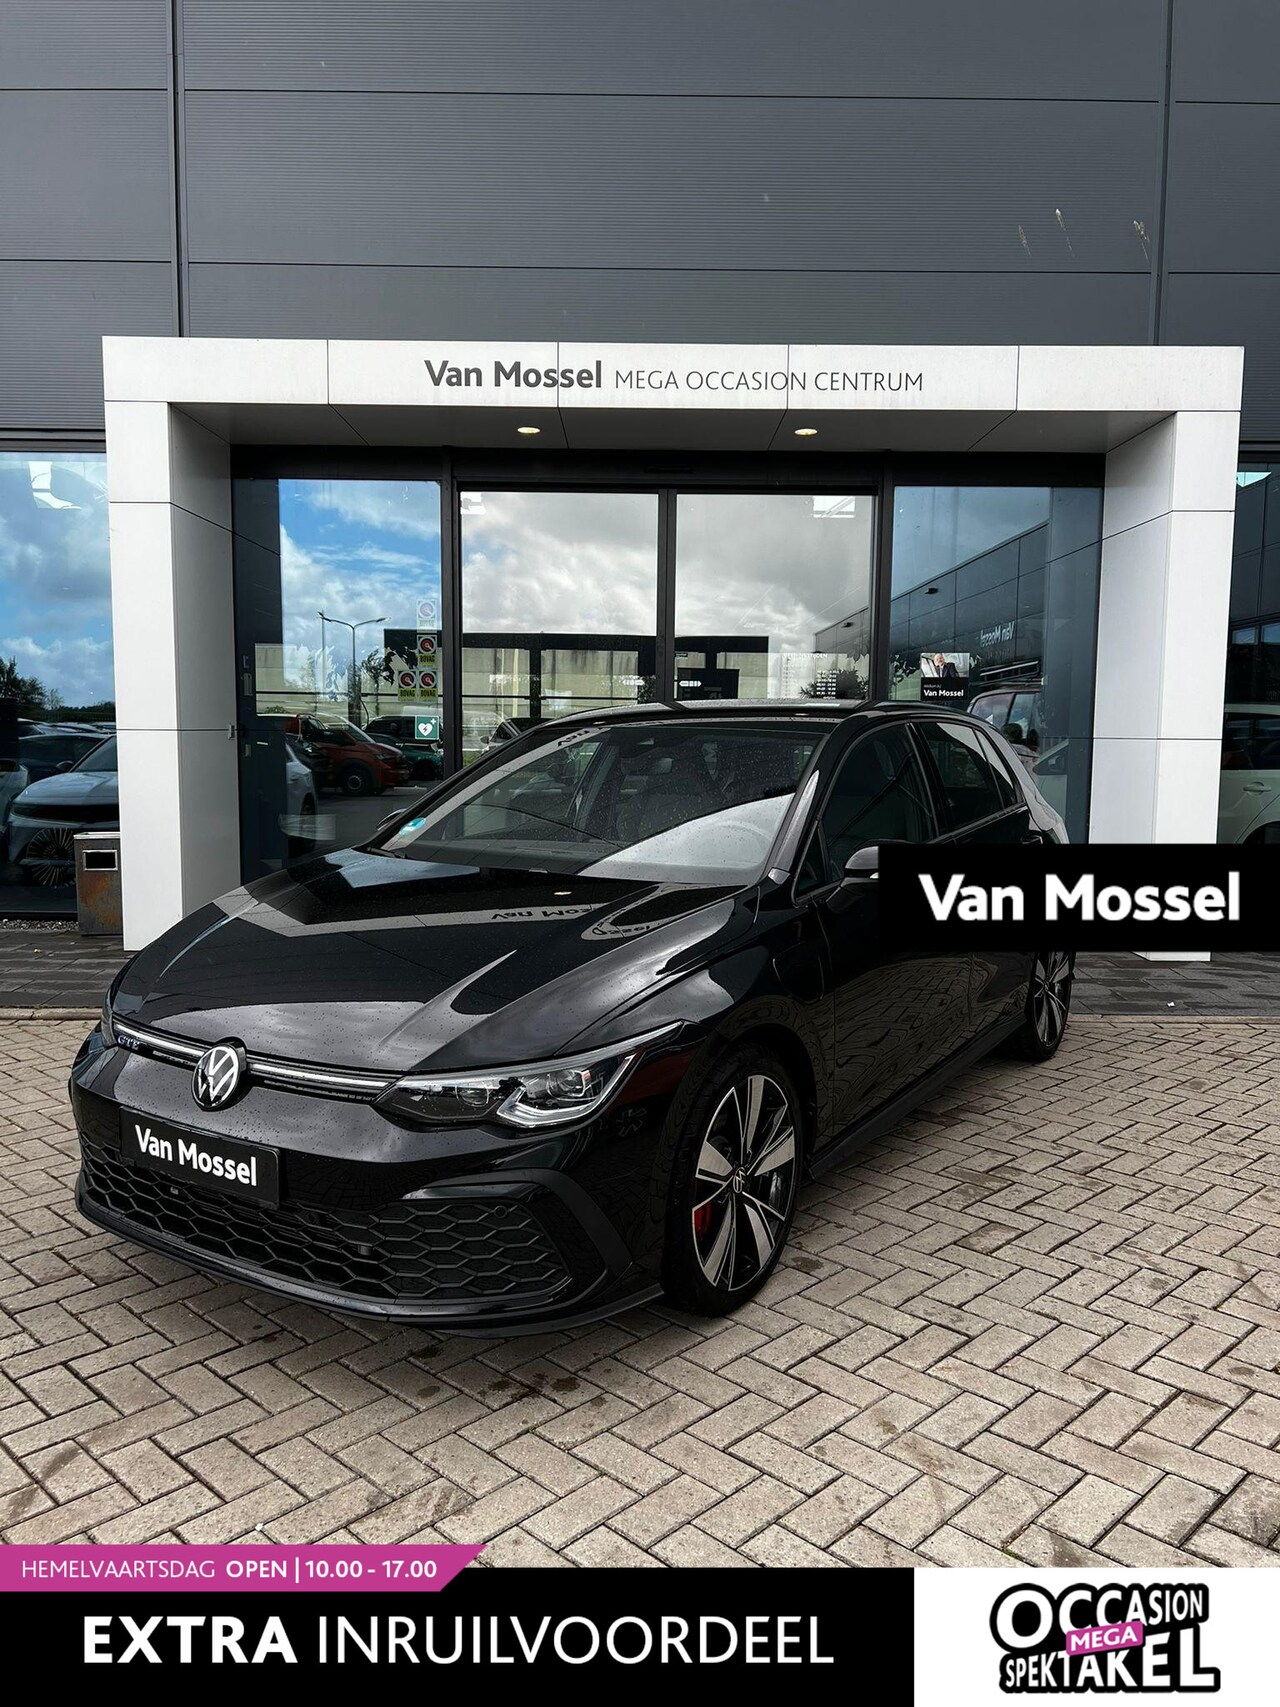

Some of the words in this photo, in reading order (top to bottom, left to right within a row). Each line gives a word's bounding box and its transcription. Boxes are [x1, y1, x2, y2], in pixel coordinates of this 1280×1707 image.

[423, 359, 483, 387] Van
[494, 360, 602, 388] Mossel
[615, 370, 679, 389] MEGA
[686, 370, 806, 391] OCCASION
[814, 372, 923, 392] CENTRUM
[117, 1034, 141, 1051] GTE
[135, 1124, 173, 1162] Van
[178, 1138, 257, 1187] Mossel
